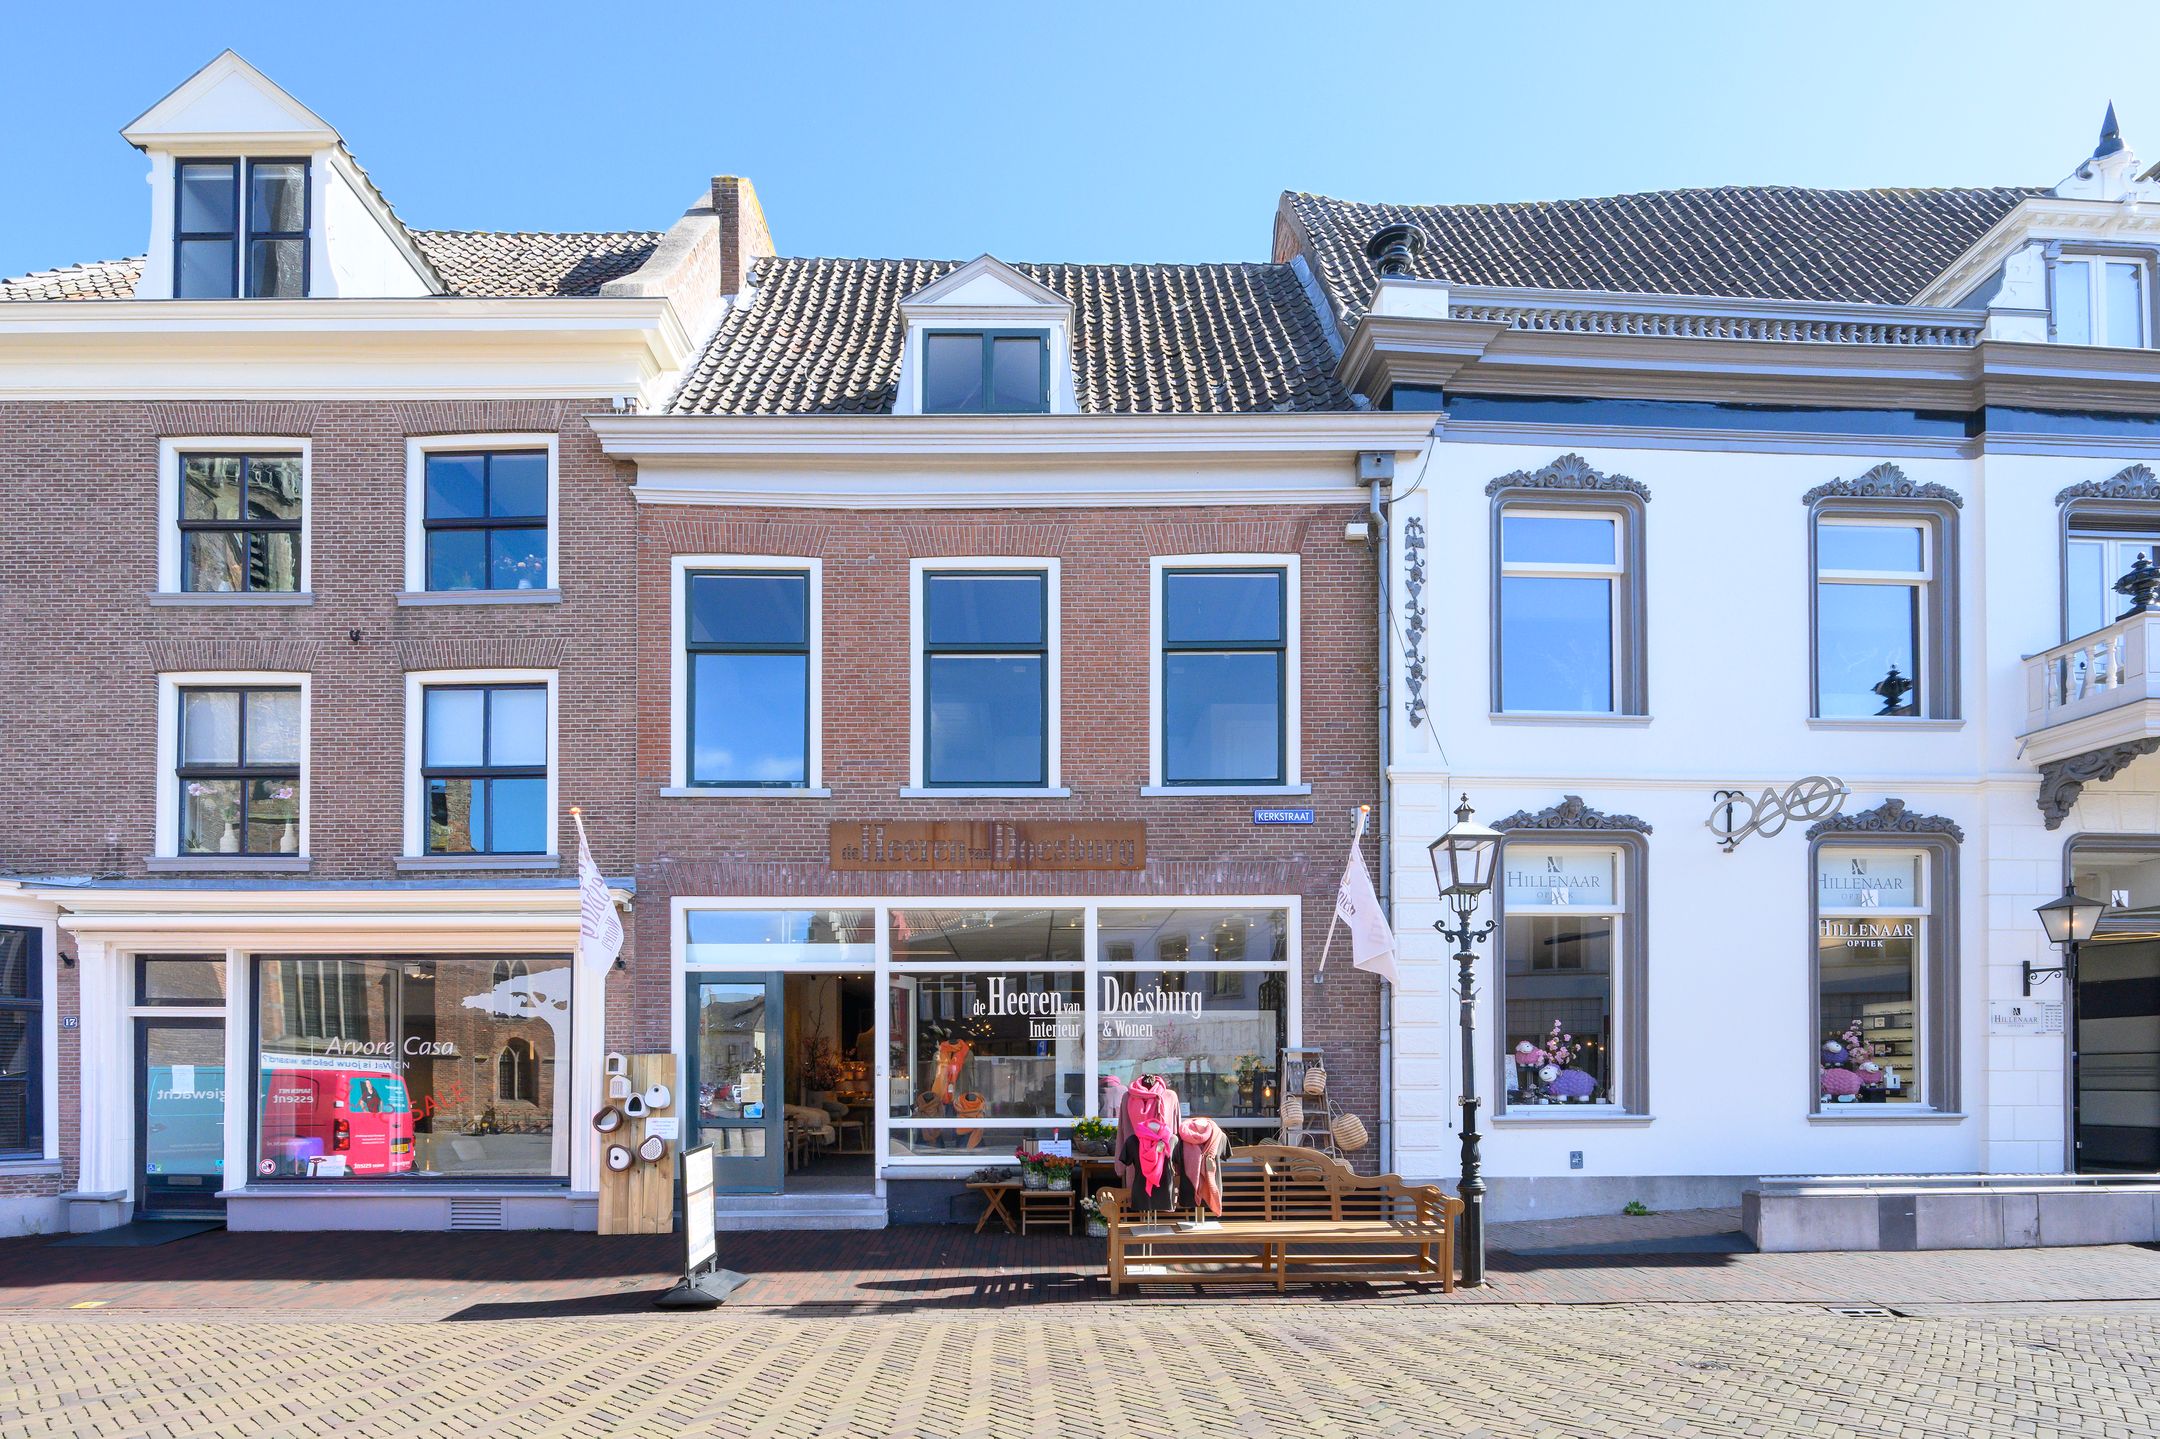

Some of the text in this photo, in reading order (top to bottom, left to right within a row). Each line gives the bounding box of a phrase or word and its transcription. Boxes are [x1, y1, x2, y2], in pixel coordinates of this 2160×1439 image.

[1258, 812, 1310, 821] KERKSTRAAT
[841, 822, 1135, 866] de Heeren van Doesburg
[1507, 871, 1600, 888] HILLENAAR
[1818, 919, 1914, 937] HILLENAAR
[1847, 939, 1884, 948] OPTIEK
[973, 976, 1202, 1019] de Heeren van Doesburg
[1029, 1020, 1153, 1038] Interieur & Wonen
[325, 1036, 455, 1055] Arvore Casa
